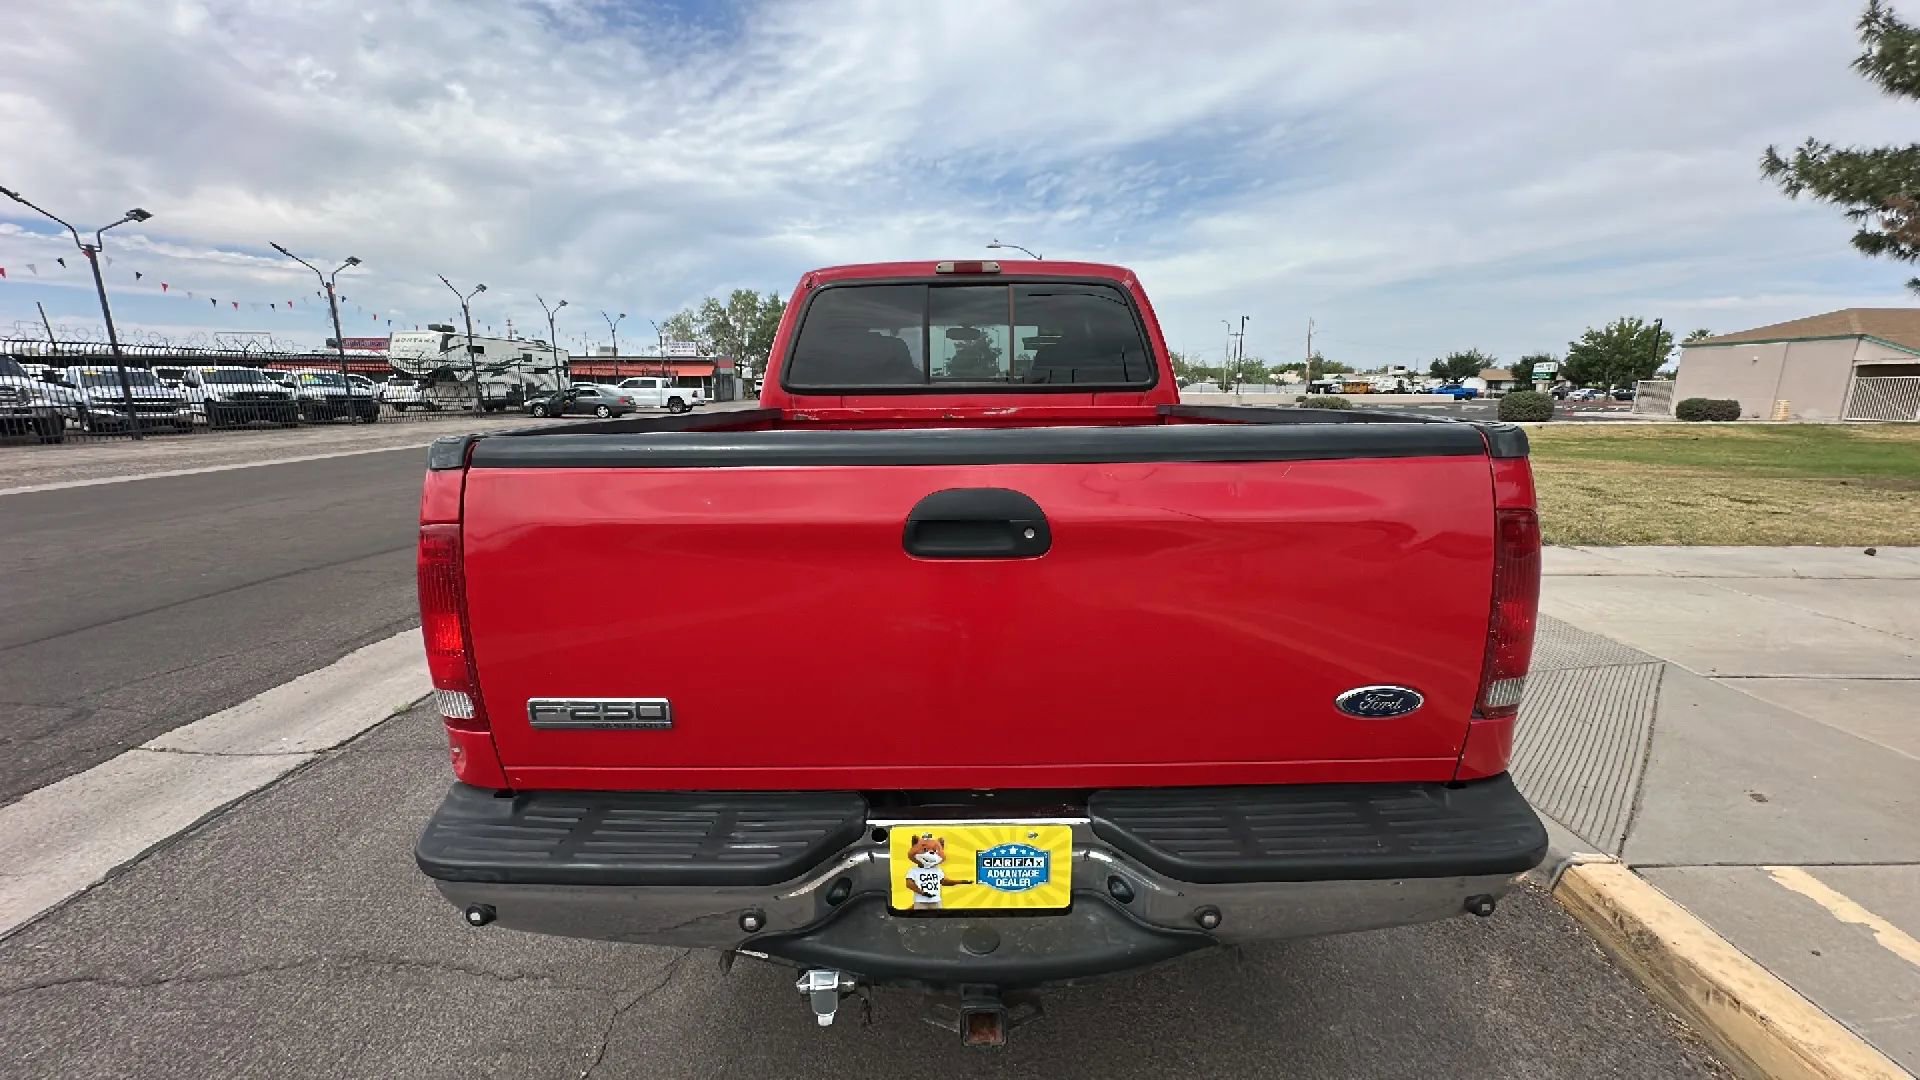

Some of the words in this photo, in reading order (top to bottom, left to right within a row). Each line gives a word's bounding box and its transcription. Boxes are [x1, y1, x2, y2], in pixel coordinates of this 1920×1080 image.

[1359, 693, 1405, 711] Ford
[982, 857, 1045, 868] CARFAX
[919, 873, 939, 882] CAR
[987, 869, 1040, 878] ADVANTAGE
[920, 882, 939, 891] FOX
[995, 878, 1031, 887] DEALER
